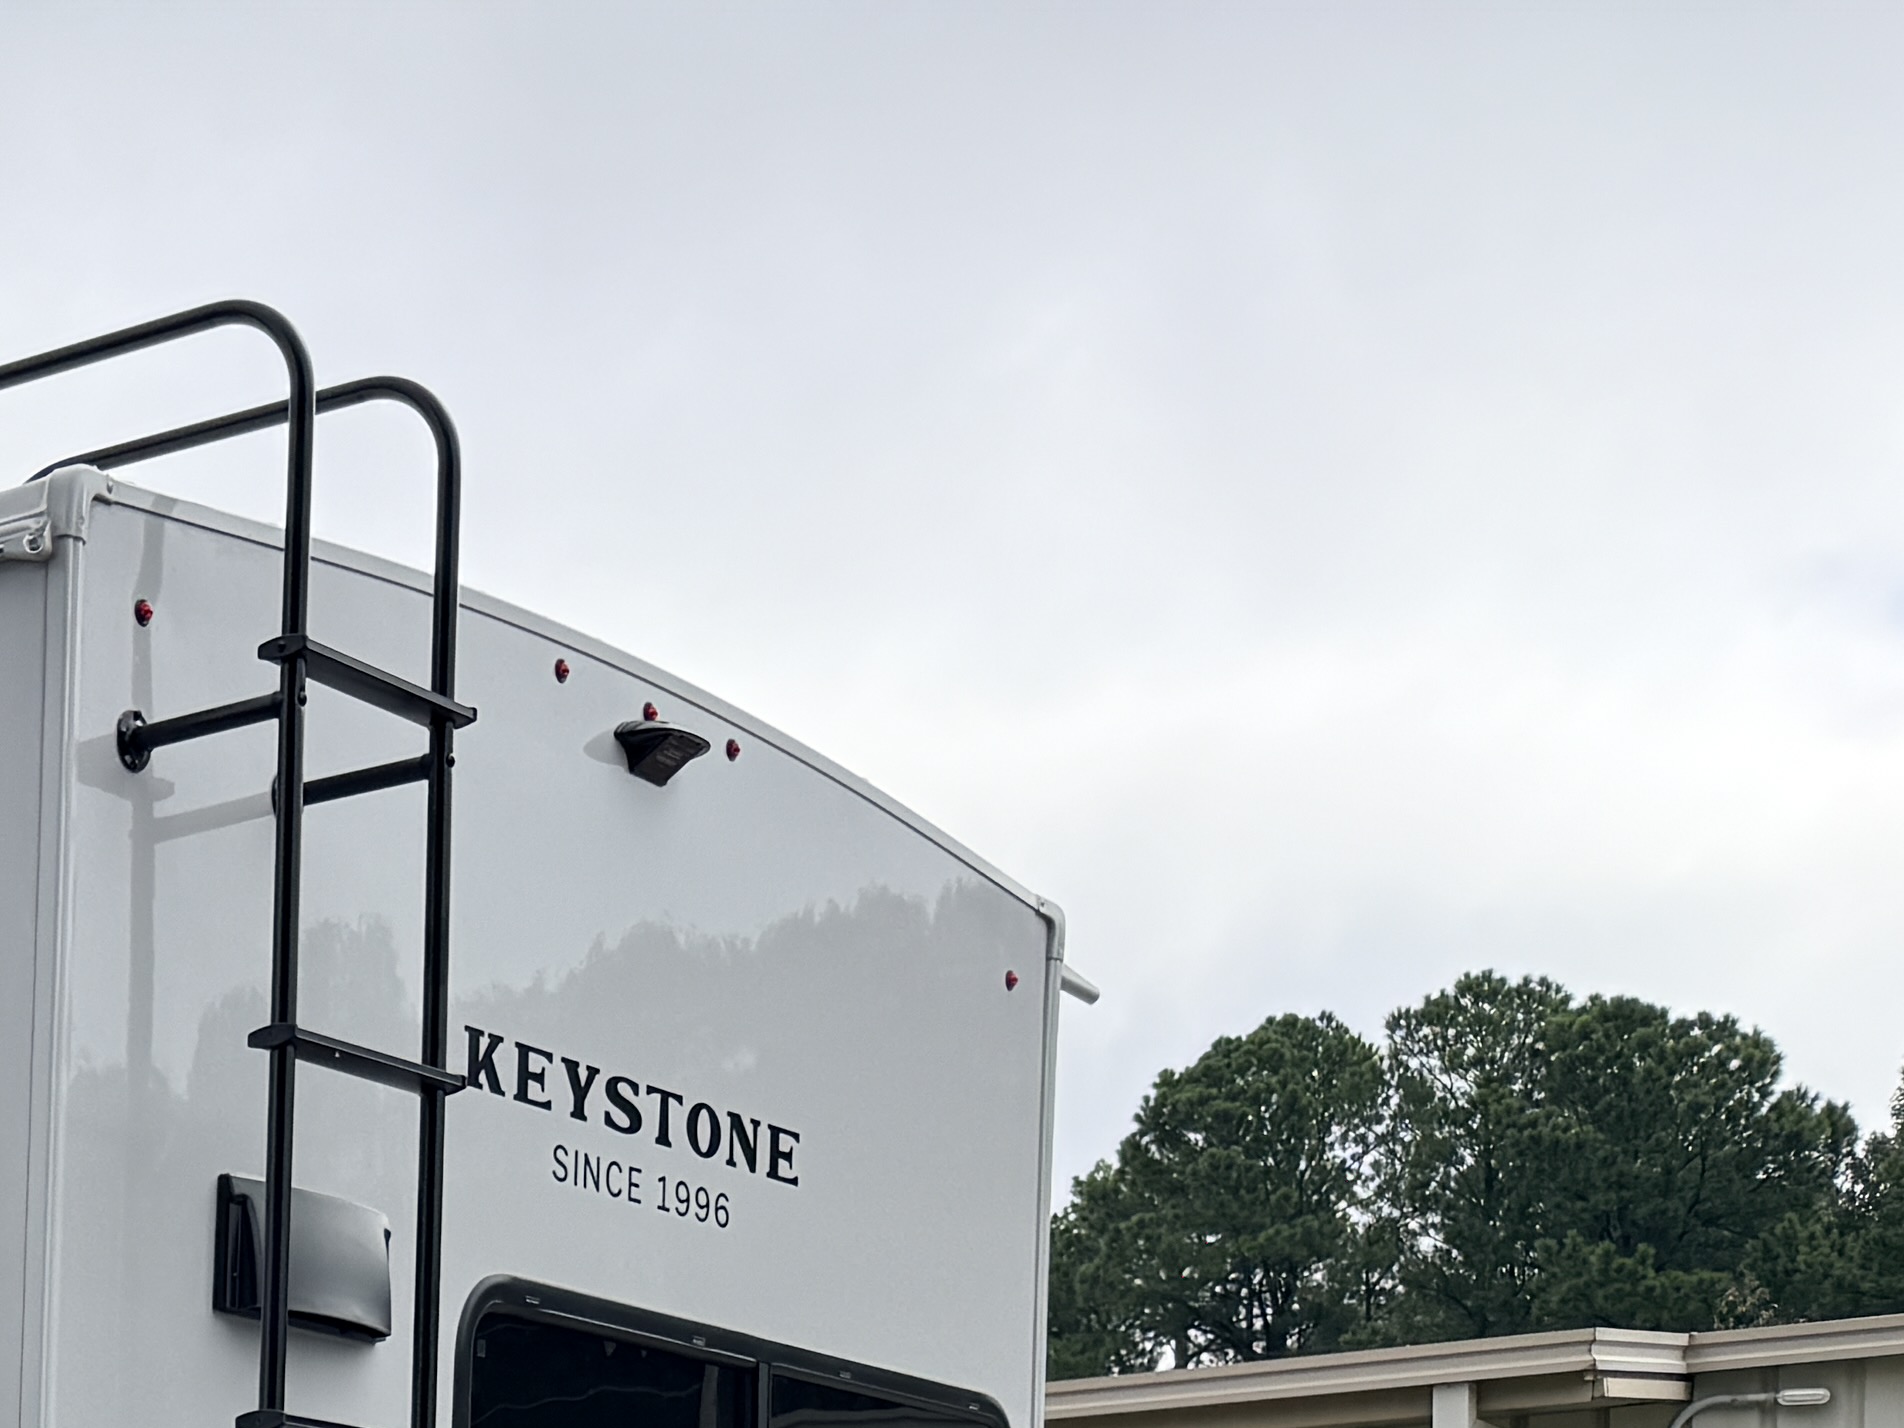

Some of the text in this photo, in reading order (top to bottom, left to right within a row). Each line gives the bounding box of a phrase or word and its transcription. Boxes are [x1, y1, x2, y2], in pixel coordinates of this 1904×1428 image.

[463, 1024, 801, 1187] KEYSTONE
[552, 1143, 731, 1230] SINCE 1996
